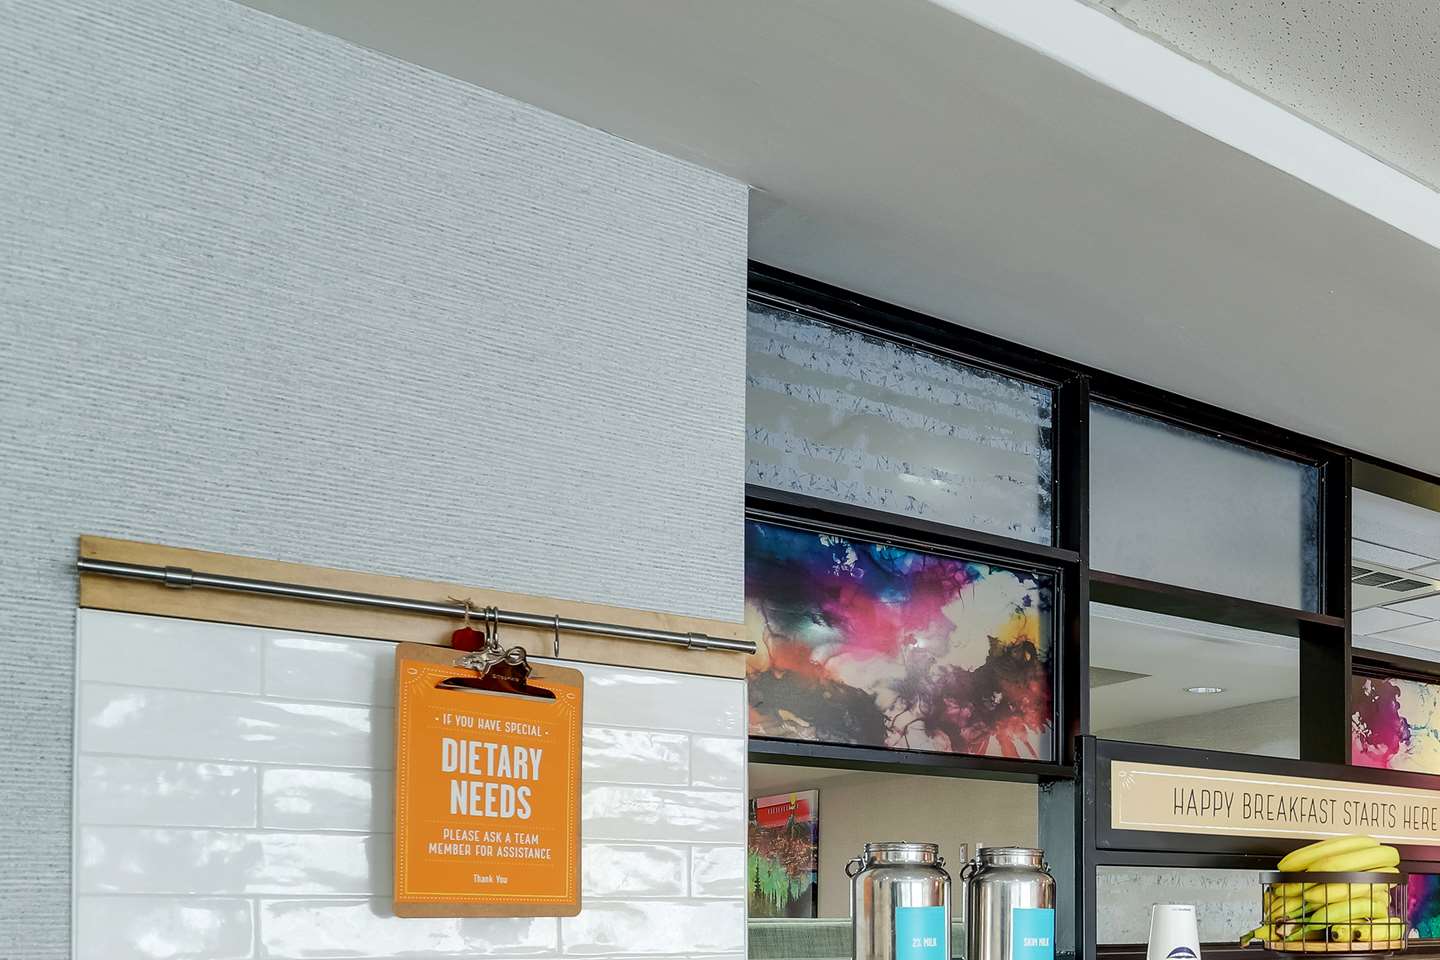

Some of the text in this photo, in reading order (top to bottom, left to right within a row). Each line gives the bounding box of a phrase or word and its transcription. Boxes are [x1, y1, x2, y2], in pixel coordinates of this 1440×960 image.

[443, 713, 542, 737] IF YOU HAVE SPECIAL
[441, 737, 543, 781] DIETARY
[450, 779, 532, 820] NEEDS
[1173, 787, 1438, 831] HAPPY BREAKFAST STARTS HERE
[443, 828, 539, 845] PLEASE ASK A TEAM
[428, 842, 552, 860] MEMBER FOR ASSISTANCE
[473, 873, 508, 884] Thank You
